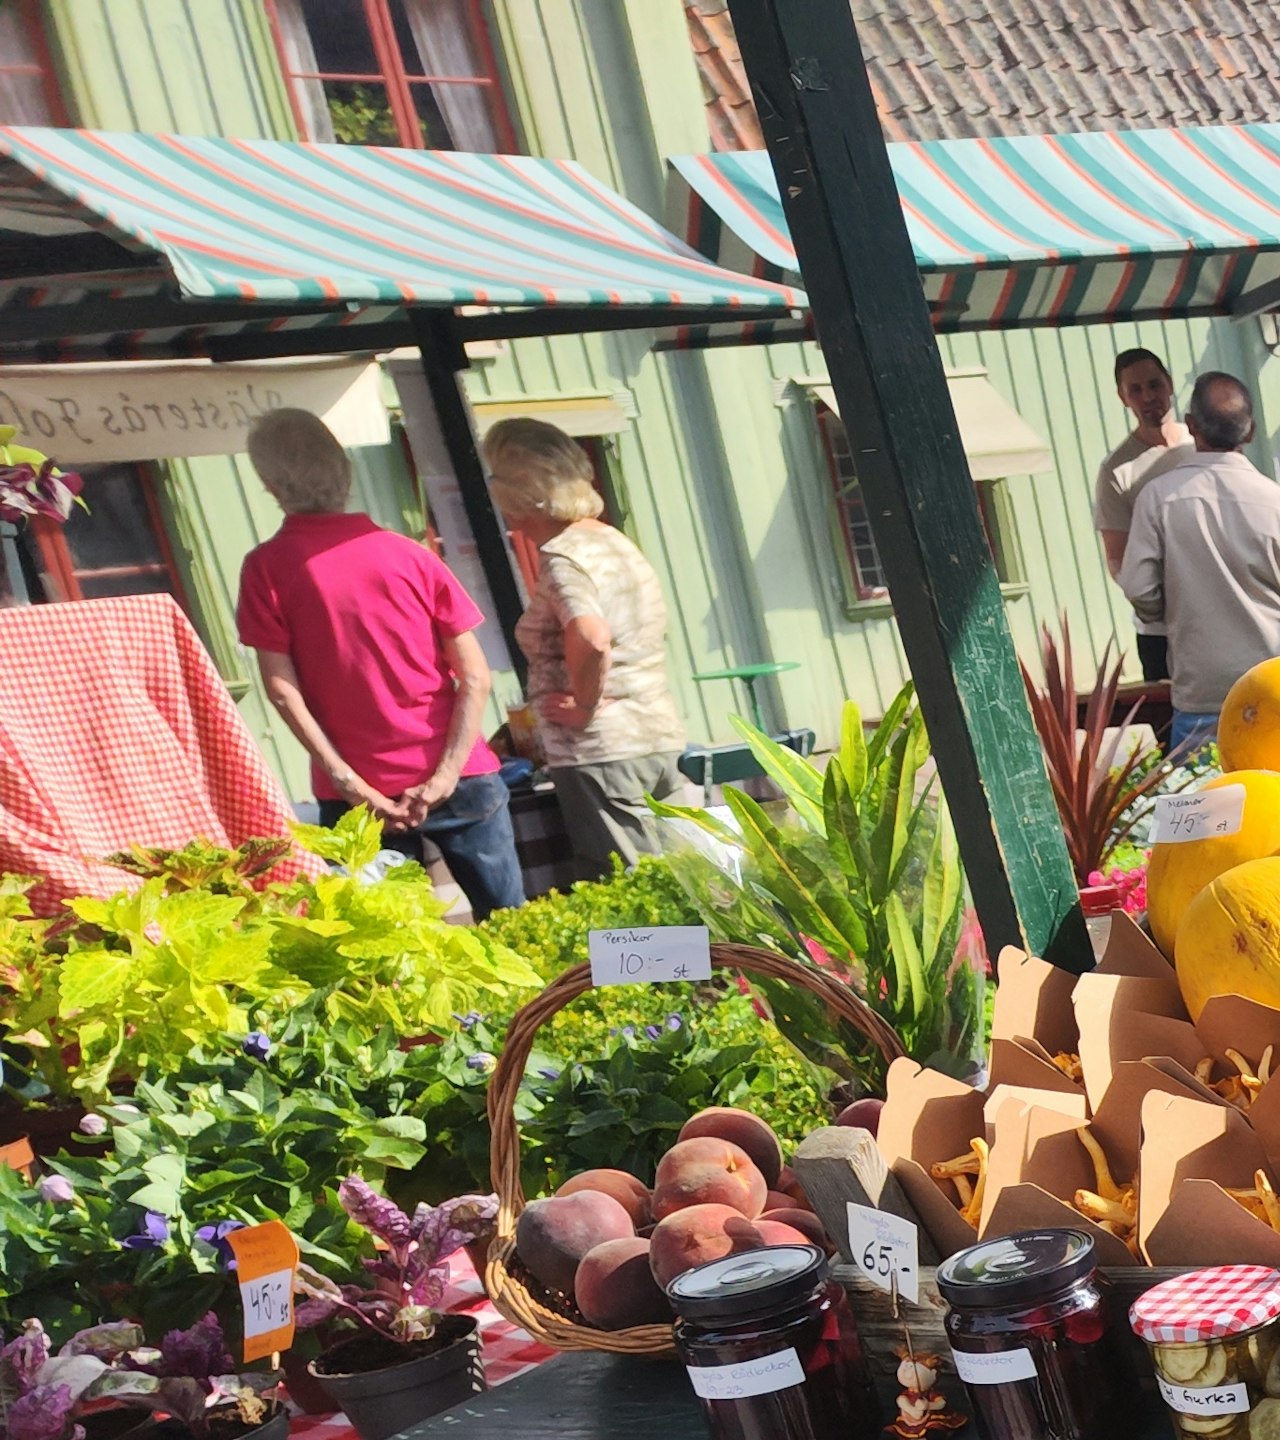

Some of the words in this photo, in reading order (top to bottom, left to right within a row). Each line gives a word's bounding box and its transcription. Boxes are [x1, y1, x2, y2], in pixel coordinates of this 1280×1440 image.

[601, 930, 654, 945] Persikor
[619, 951, 665, 975] 10:-
[672, 963, 692, 979] st
